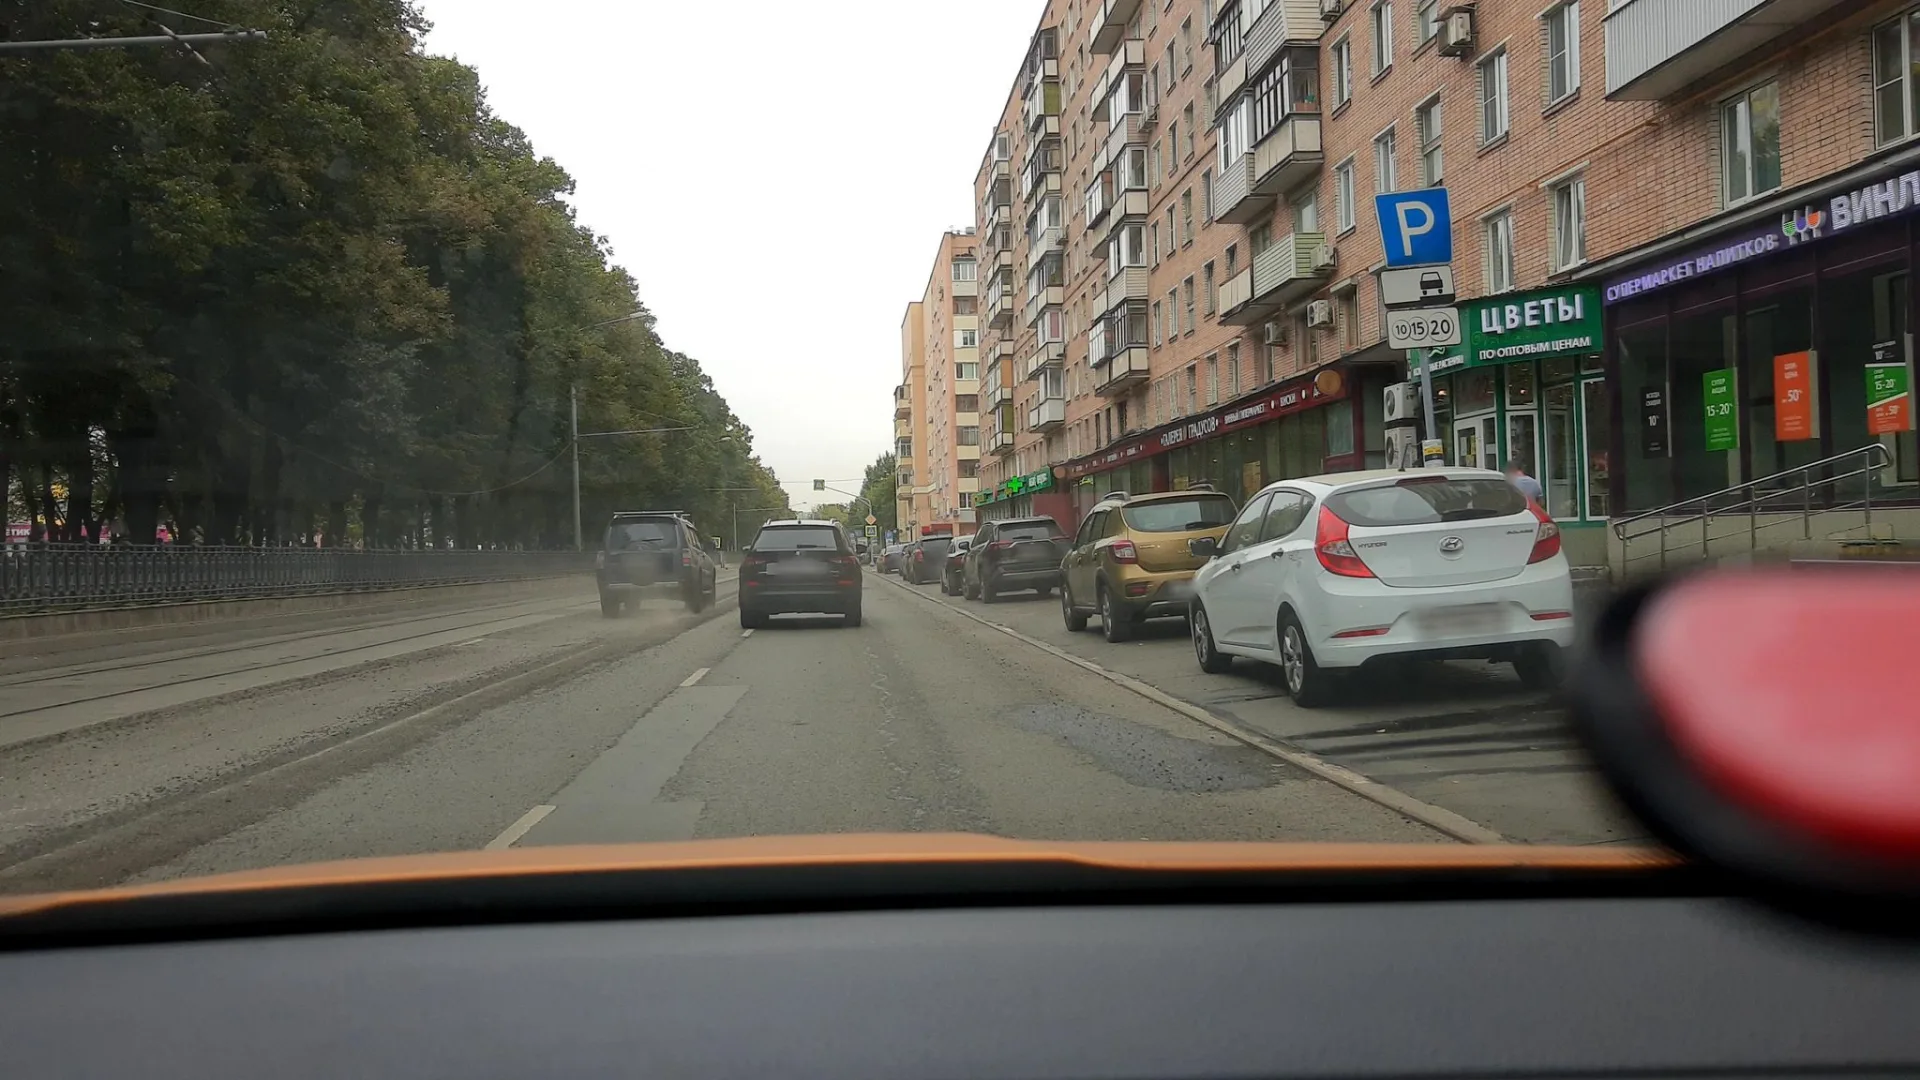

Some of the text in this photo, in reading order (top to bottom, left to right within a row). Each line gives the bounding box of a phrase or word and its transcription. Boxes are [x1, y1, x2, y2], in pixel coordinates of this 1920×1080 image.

[1831, 169, 1920, 231] ВИНЛ
[1395, 200, 1435, 257] P
[1606, 234, 1779, 301] СУПЕРМАРКЕТ НАПИТКОВ
[1395, 319, 1451, 336] 10 15 20
[1480, 293, 1585, 334] ЦВЕТЫ
[1479, 336, 1592, 360] ПО ОПТОВЫМ ЦЕНАМ
[1188, 416, 1216, 440] ГРАДУСОВ
[1357, 541, 1388, 549] HYUNDAI
